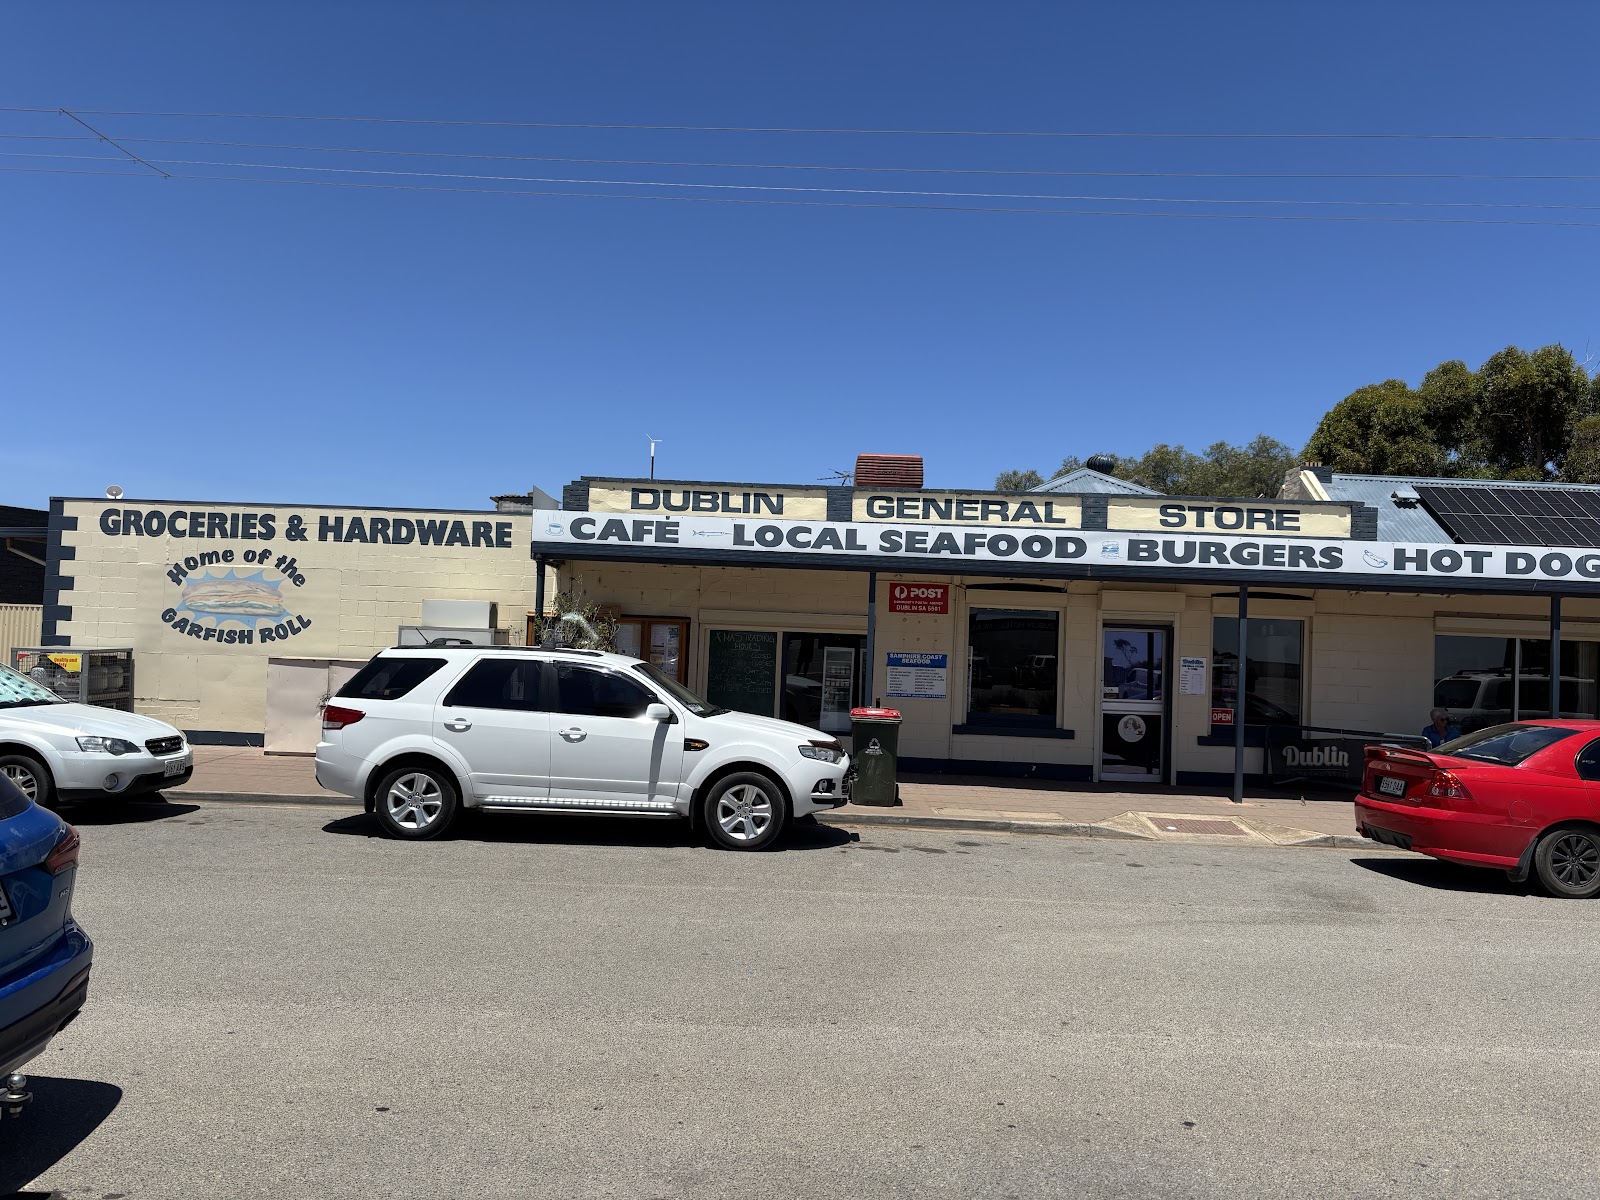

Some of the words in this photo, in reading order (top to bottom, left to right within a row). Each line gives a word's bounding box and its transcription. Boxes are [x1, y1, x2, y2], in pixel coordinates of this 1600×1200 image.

[99, 508, 276, 541] GROCERIES
[285, 514, 309, 542] &
[318, 515, 513, 548] HARDWARE
[630, 487, 784, 515] DUBLIN
[866, 495, 1066, 524] GENERAL
[1159, 504, 1301, 532] STORE
[569, 515, 680, 543] CAFÉ
[733, 523, 867, 550] LOCAL
[878, 529, 1088, 559] SEAFOOD
[1127, 538, 1343, 569] BURGERS
[1393, 548, 1493, 574] HOT
[166, 549, 235, 586] Home
[243, 548, 272, 565] of
[274, 554, 306, 588] the
[910, 587, 944, 599] POST
[161, 607, 253, 645] GARFISH
[258, 614, 312, 644] ROLL
[1212, 713, 1232, 721] OPEN
[1282, 745, 1349, 768] Dublin
